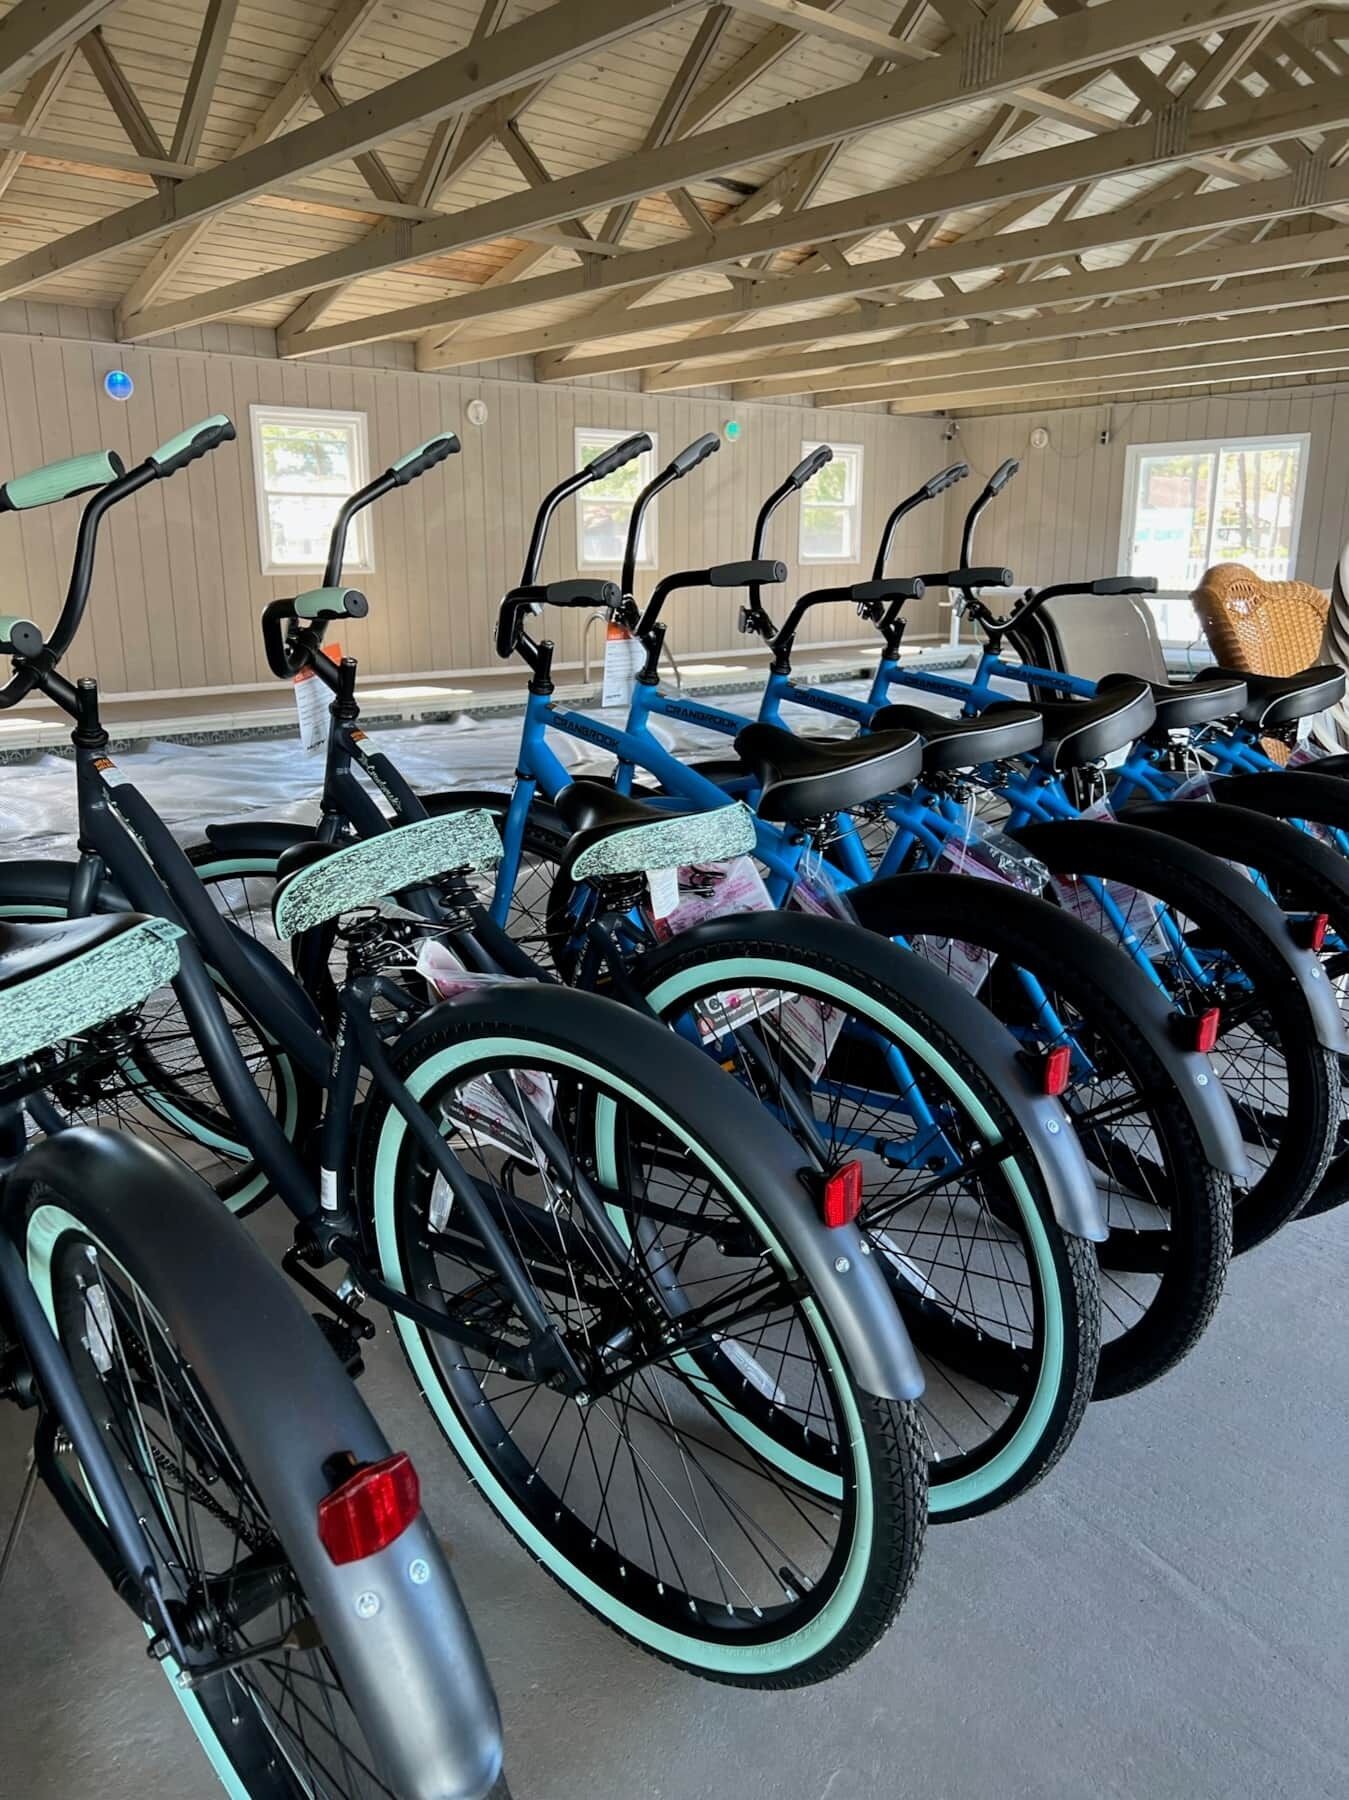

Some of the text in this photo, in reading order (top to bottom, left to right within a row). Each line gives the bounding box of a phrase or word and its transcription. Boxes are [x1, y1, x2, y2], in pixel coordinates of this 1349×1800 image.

[793, 689, 861, 714] CRANBROOK
[665, 705, 738, 728] CRANBROOK
[553, 716, 620, 748] CRANBROOK
